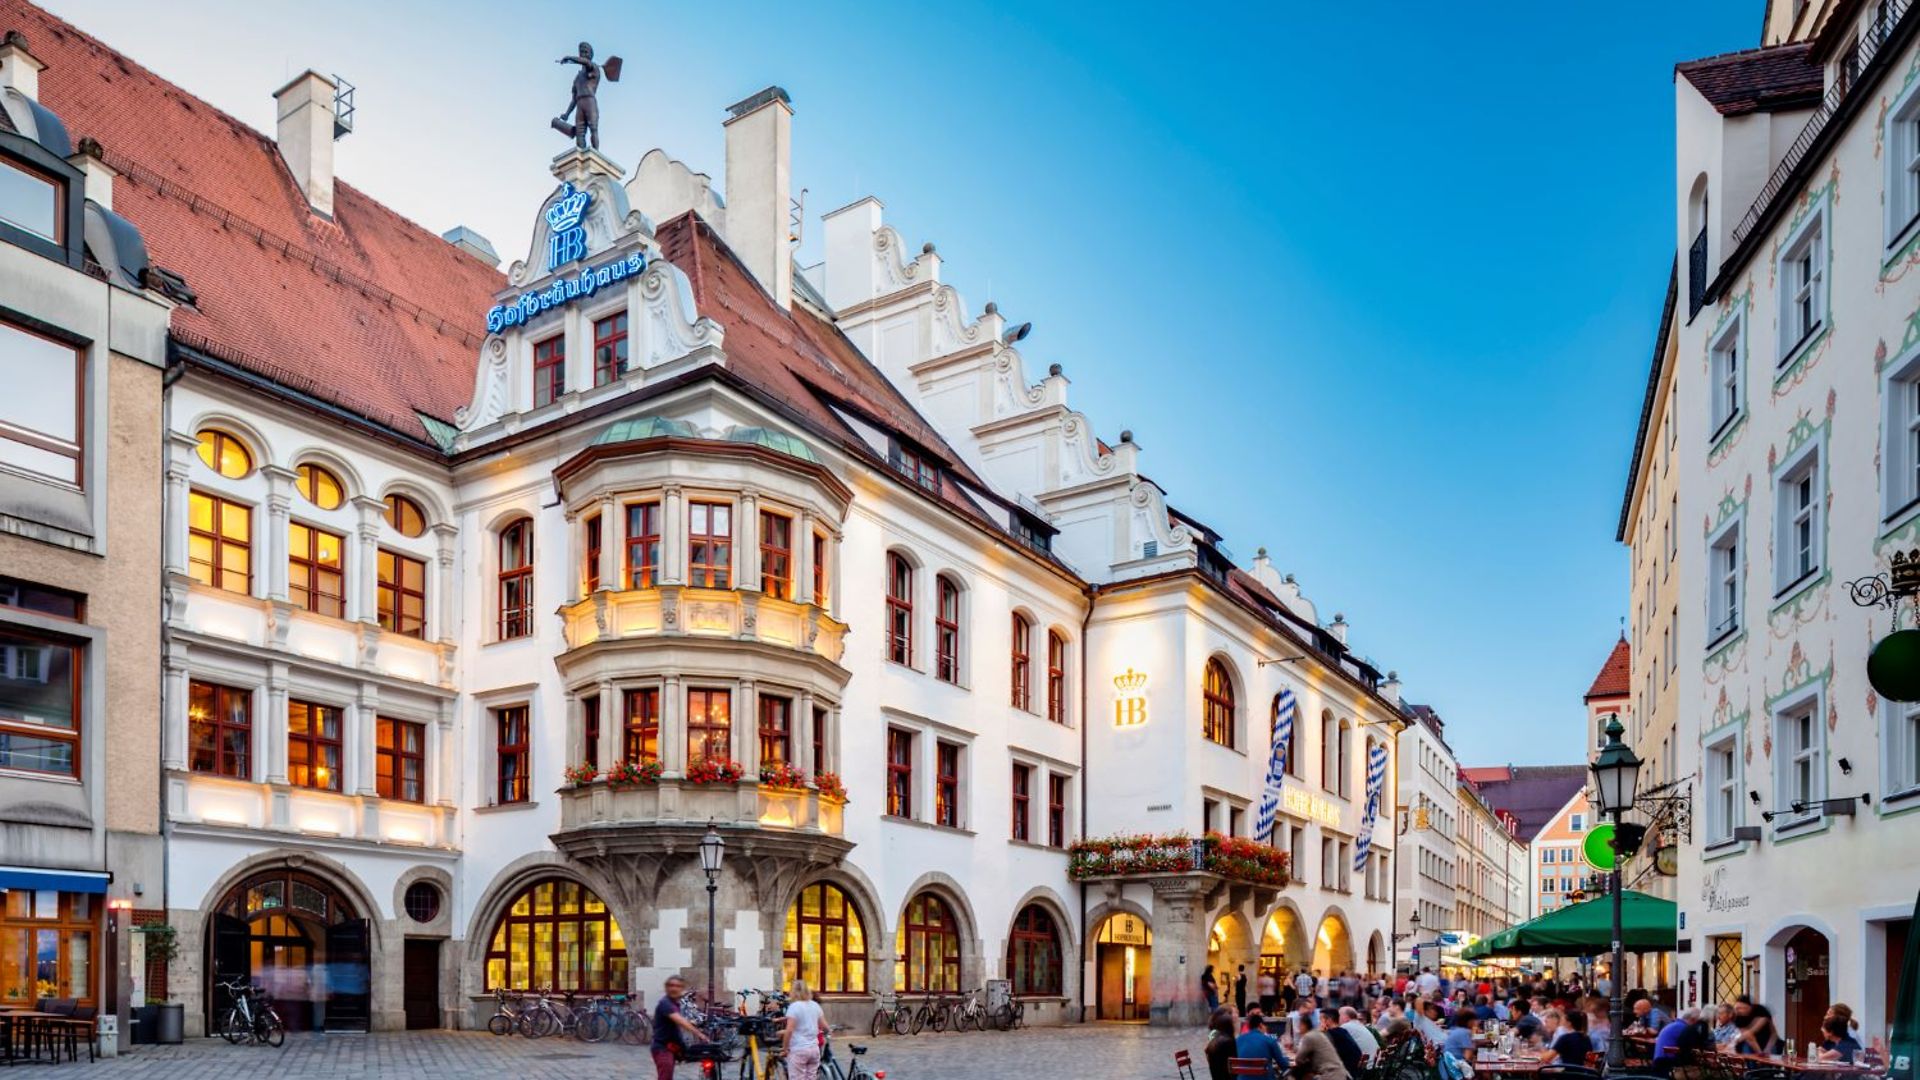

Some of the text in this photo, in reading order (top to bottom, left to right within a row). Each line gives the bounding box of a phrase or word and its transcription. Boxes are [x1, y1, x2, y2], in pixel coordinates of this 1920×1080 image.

[549, 226, 586, 271] HB
[487, 252, 646, 334] Hofbräuhaus
[1114, 697, 1148, 727] HB
